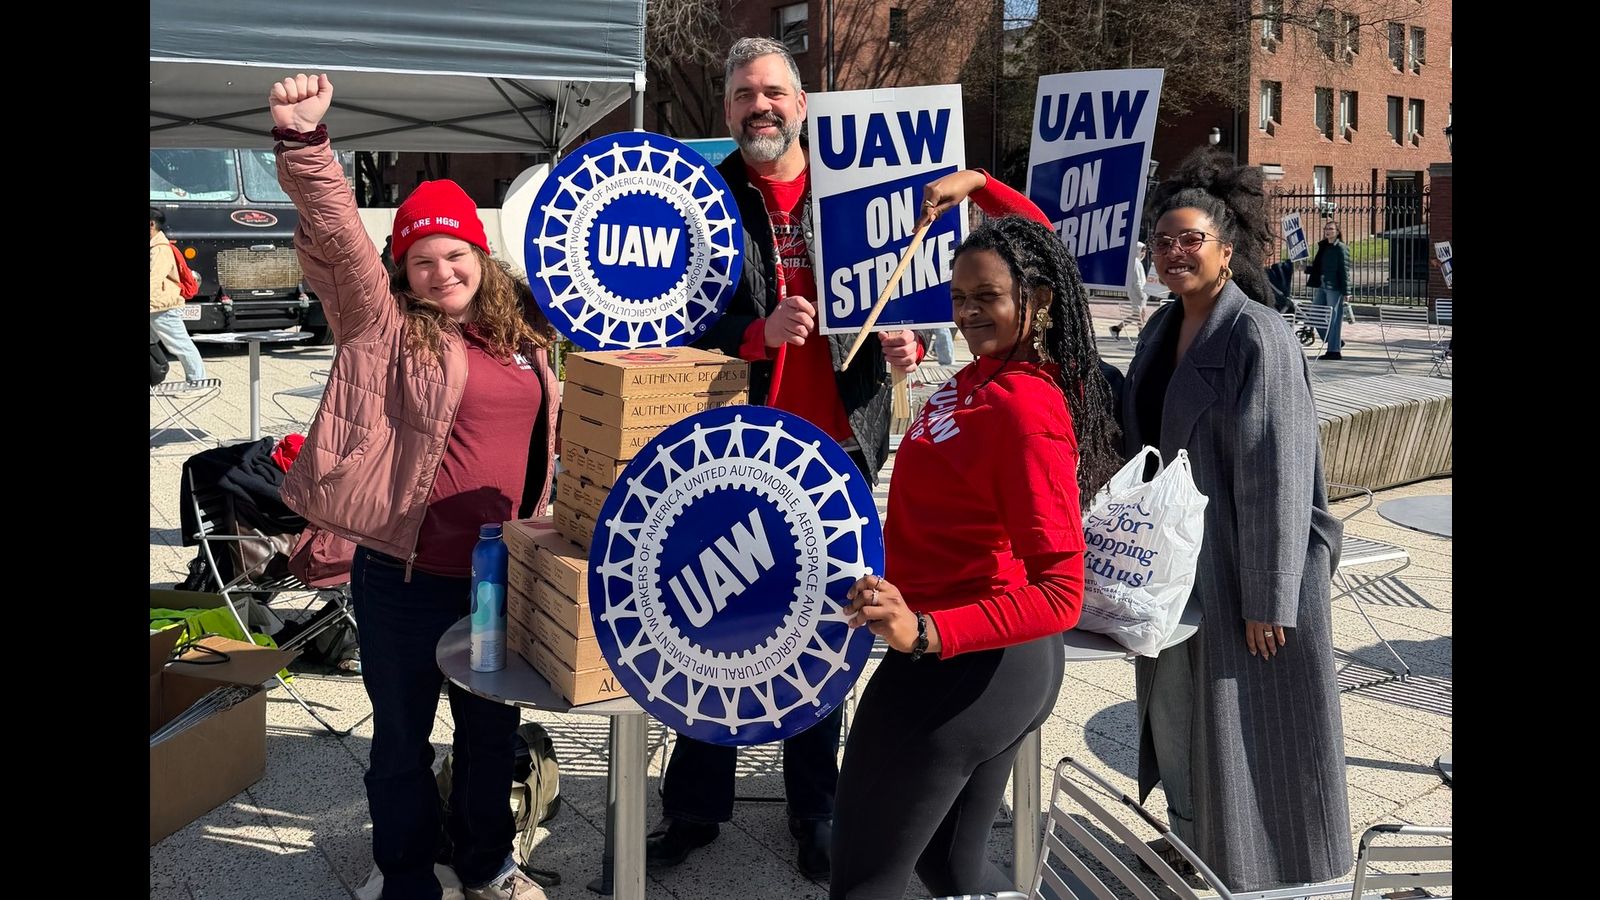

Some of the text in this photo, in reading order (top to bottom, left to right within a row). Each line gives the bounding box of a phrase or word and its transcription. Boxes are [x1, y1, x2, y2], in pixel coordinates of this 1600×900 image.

[817, 108, 951, 171] UAW
[1039, 90, 1149, 142] UAW
[1060, 159, 1102, 213] ON
[401, 217, 460, 238] WE ARE HGSU
[865, 187, 915, 249] ON
[1055, 201, 1130, 257] RIKE
[1283, 216, 1300, 232] UAW
[570, 177, 706, 317] UNITED AUTOMOBILE, AEROSPACE AND AGRICULTURAL IMPLEMENT WORKERS OF AMERICA
[598, 223, 680, 268] UAW
[831, 231, 955, 319] STRIKE
[631, 372, 693, 385] AUTHENTIC
[698, 370, 738, 382] RECIPES
[631, 402, 692, 417] AUTHENTIC
[1083, 527, 1158, 567] hopping
[1106, 512, 1154, 534] for
[638, 465, 819, 680] UNITED AUTOMOBILE, AEROSPACE AND AGRICULTURAL IMPLEMENT WORKERS OF AMERICA
[668, 507, 776, 628] UAW
[1116, 569, 1153, 588] us!
